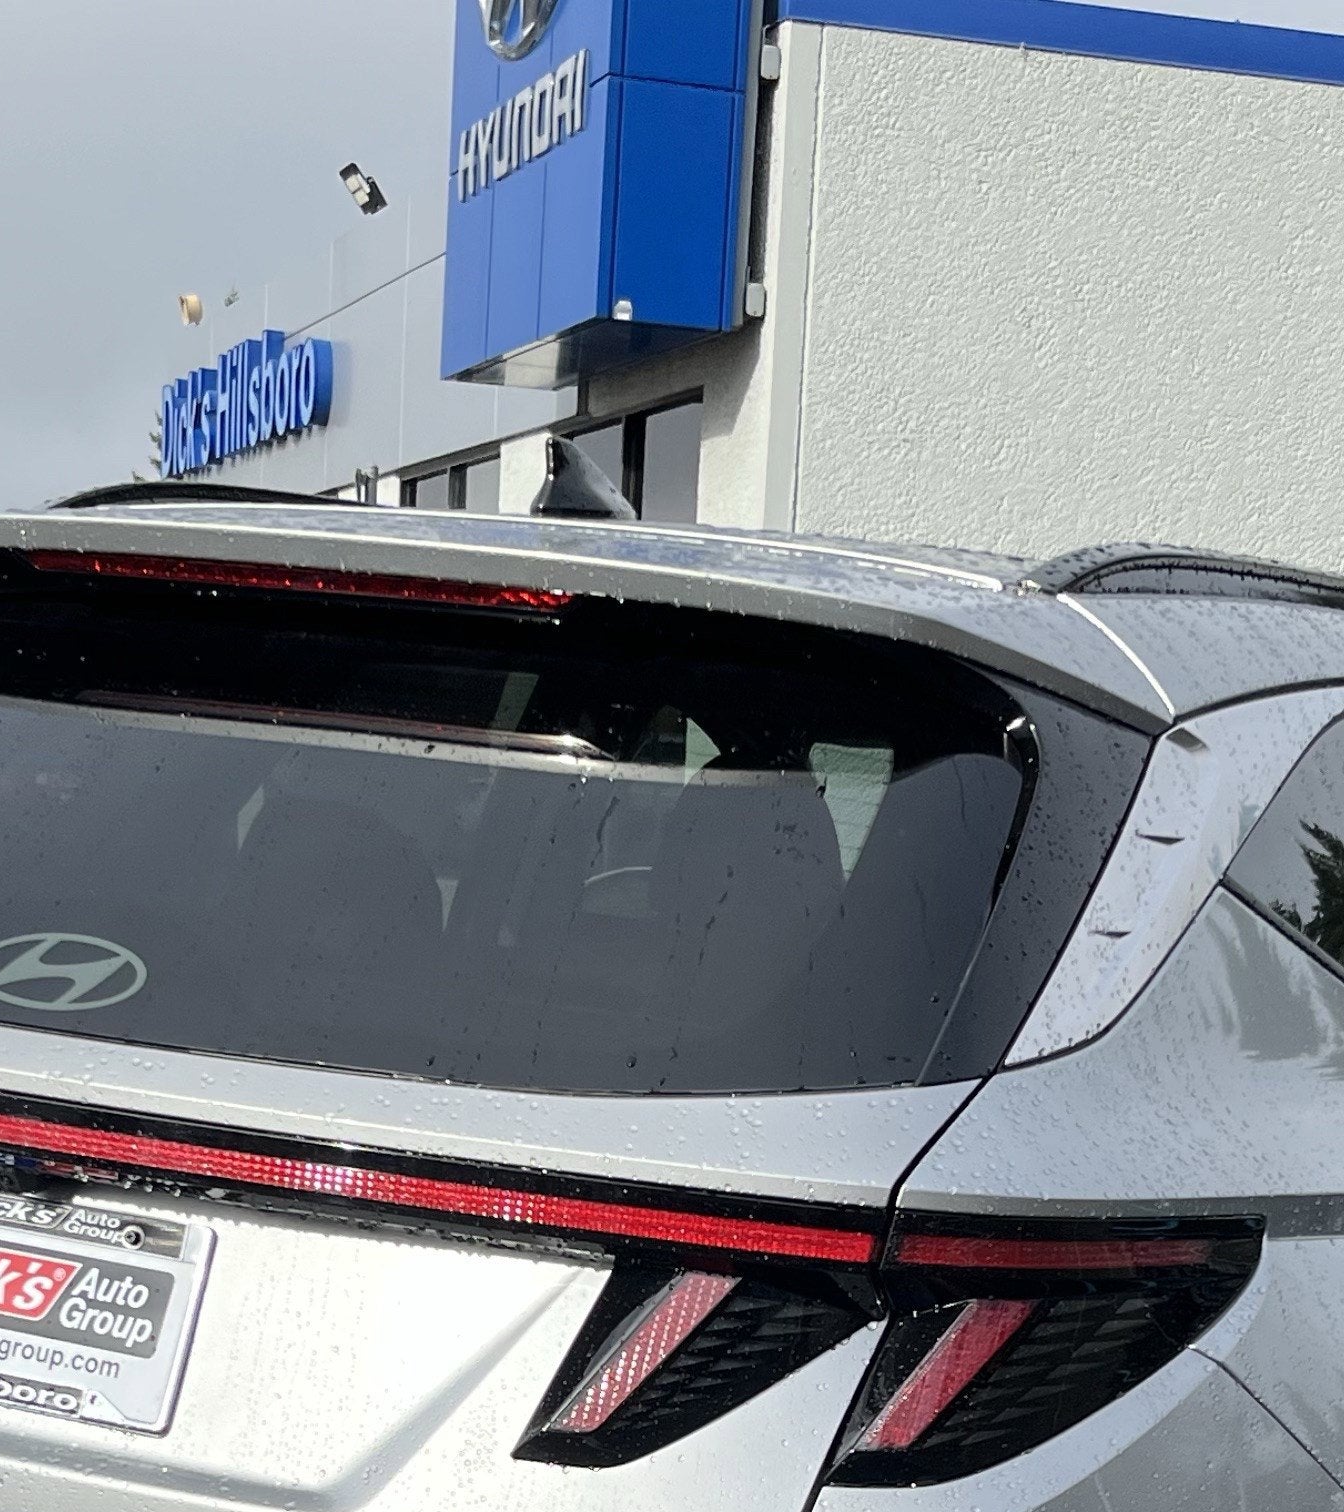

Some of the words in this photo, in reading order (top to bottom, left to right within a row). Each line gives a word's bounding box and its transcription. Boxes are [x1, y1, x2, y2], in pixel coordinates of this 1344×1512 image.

[458, 48, 588, 203] HYUNDAI
[160, 367, 212, 480] Dick's
[215, 330, 318, 459] Hillsboro
[63, 1219, 125, 1244] Group
[71, 1208, 122, 1229] Auto
[70, 1267, 149, 1310] Auto
[59, 1297, 154, 1347] Group
